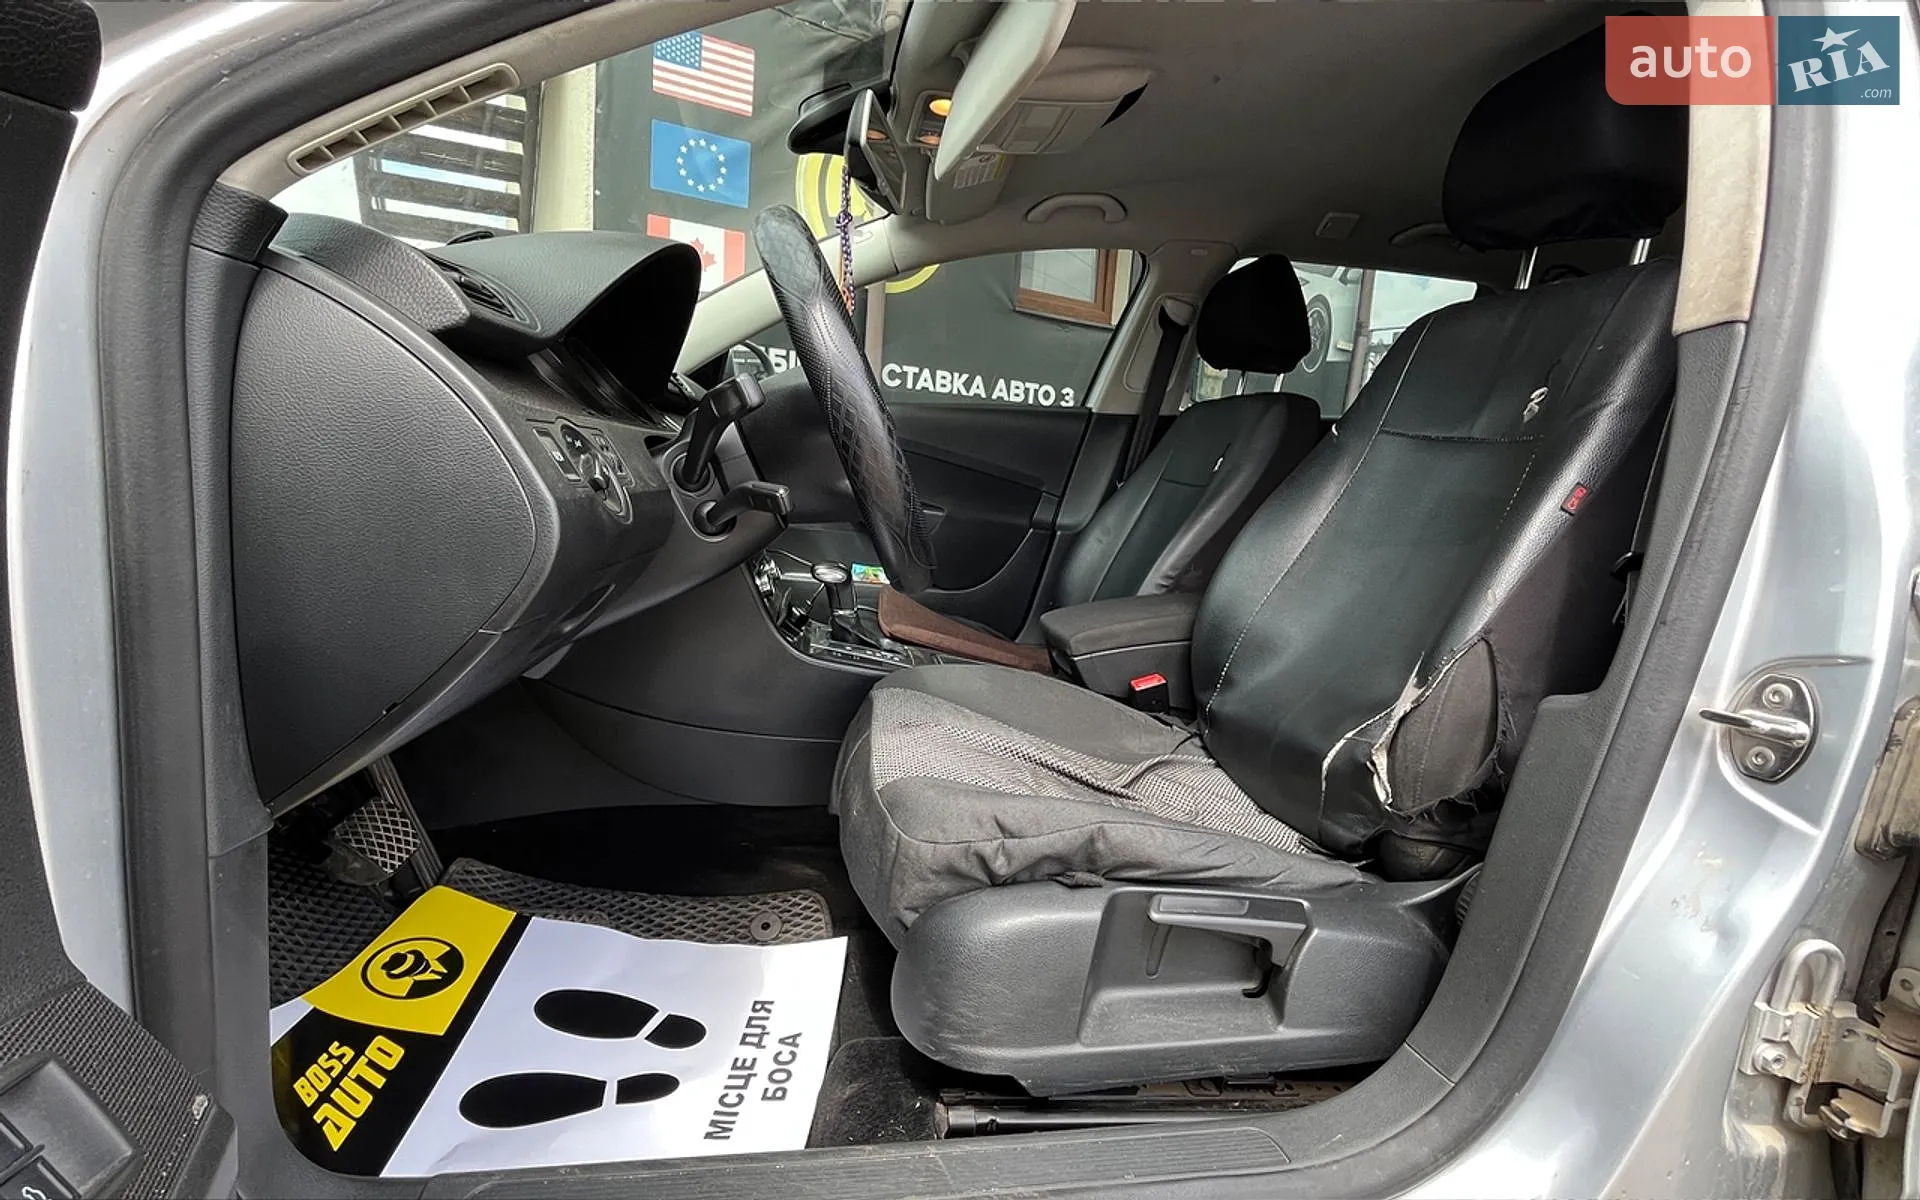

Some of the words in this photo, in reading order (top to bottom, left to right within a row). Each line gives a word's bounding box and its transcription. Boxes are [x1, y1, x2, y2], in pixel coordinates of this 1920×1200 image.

[881, 362, 987, 399] СТАВКА
[991, 378, 1056, 407] АВТО
[292, 1040, 355, 1108] BOSS
[312, 1035, 405, 1152] AUTO
[703, 1056, 758, 1140] МІСЦЕ
[739, 1000, 775, 1049] ДЛЯ
[761, 1032, 803, 1101] БОСА
